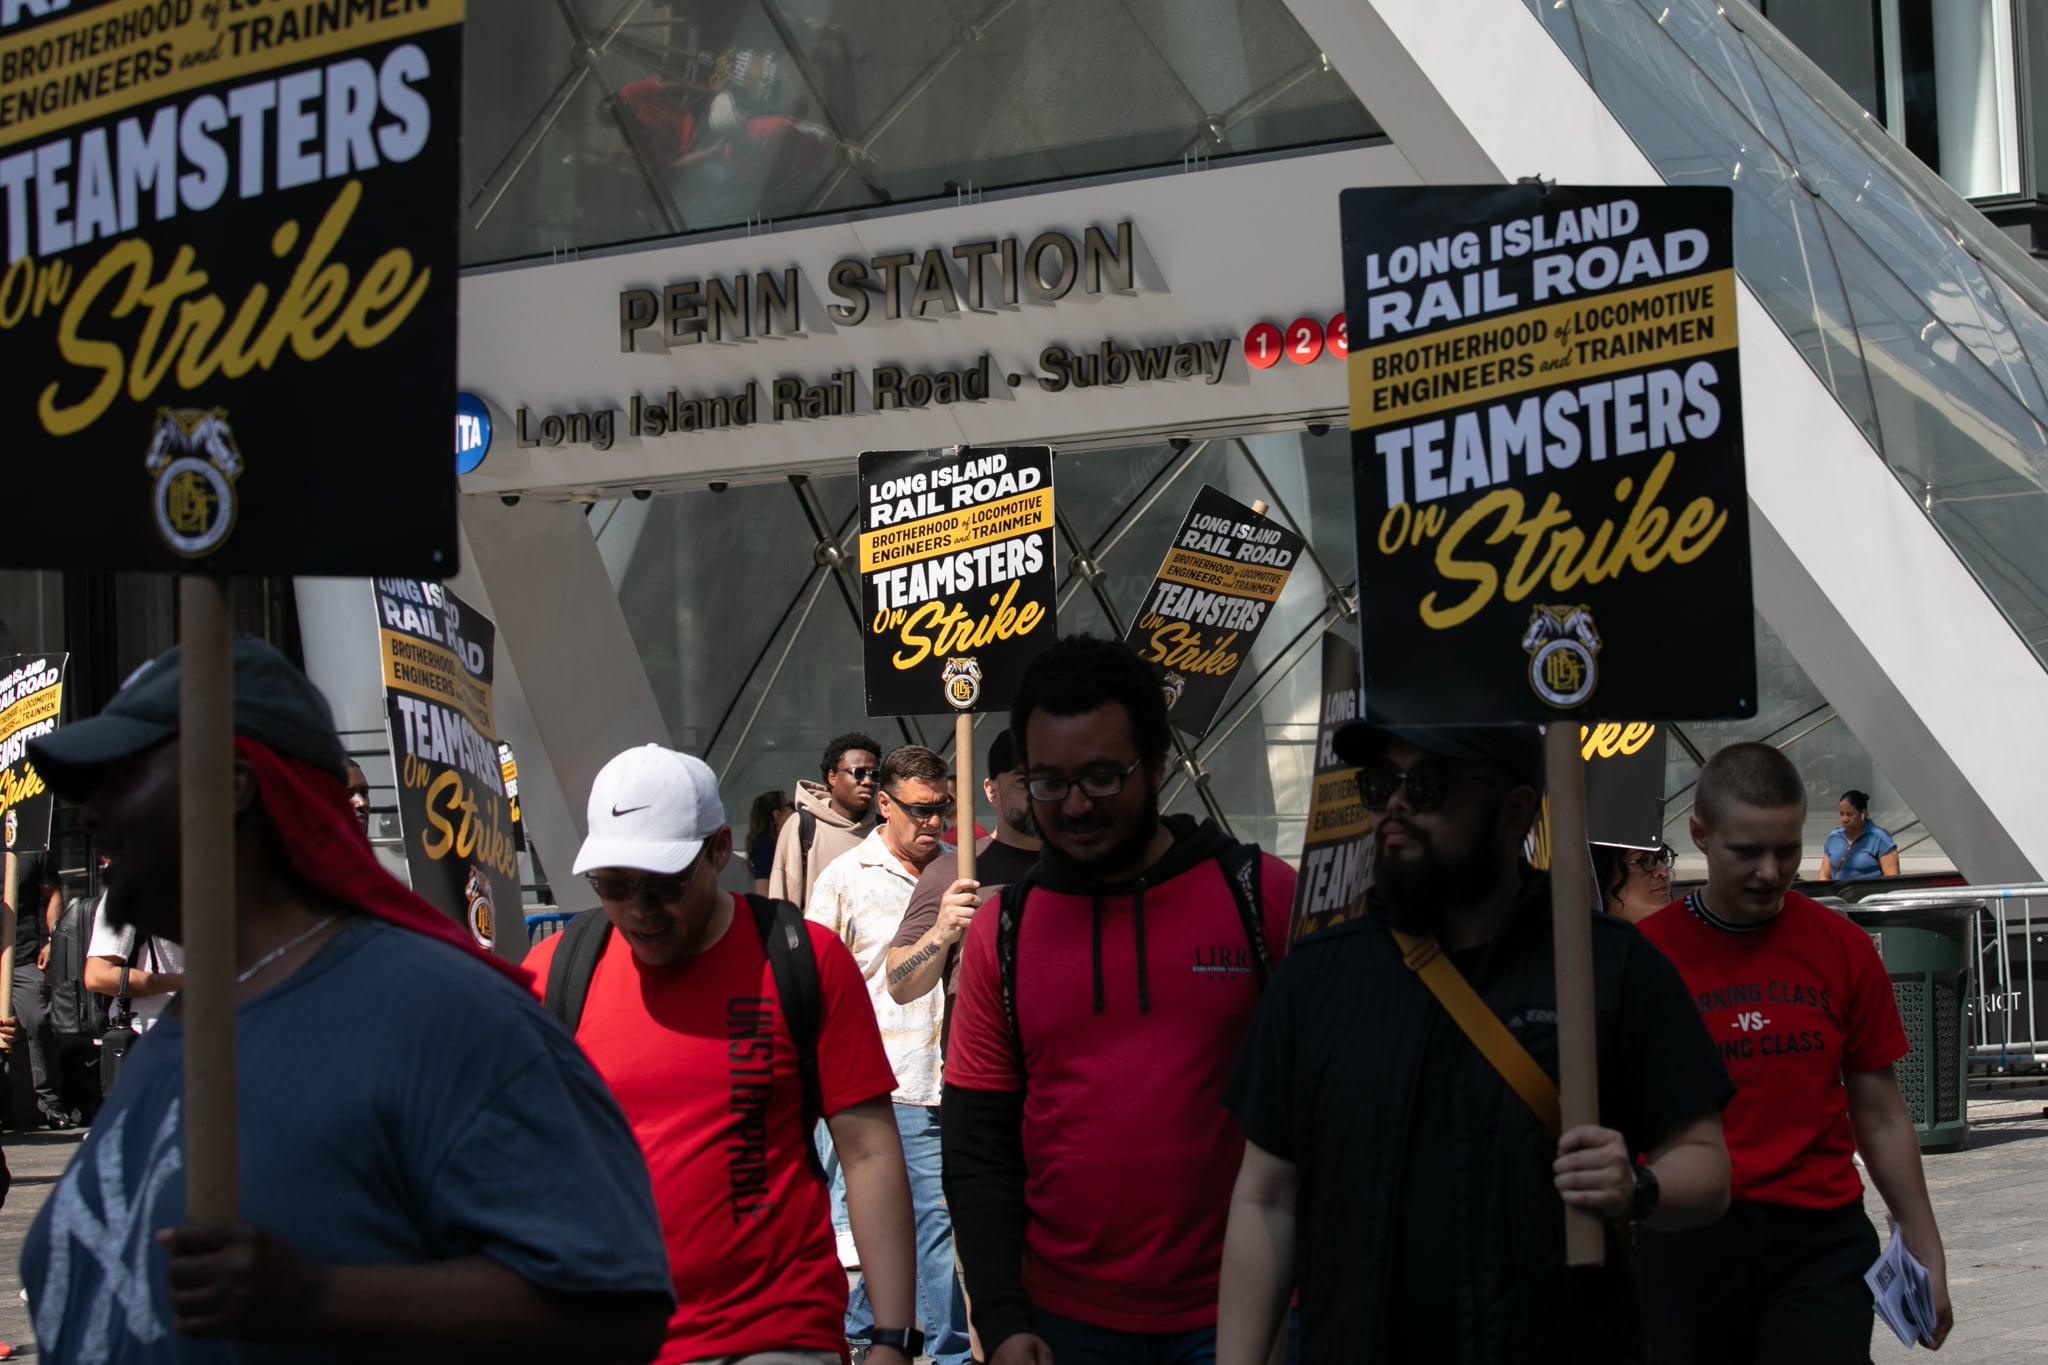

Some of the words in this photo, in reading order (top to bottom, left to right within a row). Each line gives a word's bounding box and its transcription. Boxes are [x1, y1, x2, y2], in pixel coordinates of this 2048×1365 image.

[2, 0, 192, 85] BROTHERHOOD
[0, 43, 174, 128] ENGINEERS
[179, 31, 226, 71] and
[0, 44, 431, 266] TEAMSTERS
[1366, 232, 1481, 291] LONG
[1490, 199, 1640, 262] ISLAND
[0, 256, 72, 329] On
[38, 179, 431, 436] Strike
[619, 268, 801, 353] PENN
[827, 221, 1134, 326] STATION
[1368, 270, 1519, 341] RAIL
[1533, 228, 1710, 302] ROAD
[1372, 320, 1548, 382] BROTHERHOOD
[1554, 318, 1573, 349] of
[1574, 285, 1715, 335] LOCOMOTIVE
[1372, 353, 1535, 413] ENGINEERS
[1539, 349, 1574, 375] and
[1576, 315, 1715, 365] TRAINMEN
[516, 407, 615, 451] Long
[629, 381, 757, 437] Island
[772, 370, 856, 420] Rail
[872, 355, 990, 410] Road
[1038, 338, 1232, 392] Subway
[456, 414, 482, 454] TA
[1375, 360, 1722, 510] TEAMSTERS
[870, 473, 927, 504] LONG
[931, 453, 1008, 489] ISLAND
[870, 497, 945, 529] RAIL
[951, 466, 1041, 510] ROAD
[872, 517, 959, 549] BROTHERHOOD
[961, 515, 971, 529] of
[972, 495, 1043, 525] LOCOMOTIVE
[872, 534, 952, 565] ENGINEERS
[954, 532, 971, 546] and
[973, 510, 1042, 540] TRAINMEN
[1180, 529, 1233, 558] RAIL
[1235, 542, 1293, 568] ROAD
[1190, 513, 1232, 536] LONG
[1230, 522, 1282, 546] ISLAND
[1377, 501, 1447, 555] On
[1418, 450, 1729, 630] Strike
[873, 533, 1044, 613] TEAMSTERS
[1166, 565, 1224, 587] ENGINEERS
[1233, 580, 1277, 596] TRAINMEN
[1172, 553, 1235, 576] BROTHERHOOD
[1240, 567, 1284, 584] LOCOMOTIVE
[381, 595, 444, 642] RAIL
[873, 607, 908, 634] On
[892, 578, 1046, 670] Strike
[1138, 610, 1166, 630] On
[1150, 582, 1266, 632] TEAMSTERS
[1138, 621, 1240, 676] Strike
[16, 667, 59, 700] ROAD
[393, 661, 456, 698] ENGINEERS
[1324, 688, 1355, 724] LONG
[398, 695, 503, 796] TEAMSTERS
[403, 751, 431, 790] On
[422, 769, 516, 880] Strike
[1194, 946, 1247, 967] LIRR
[1768, 981, 1831, 1012] CLASS
[1760, 1031, 1825, 1057] CLASS
